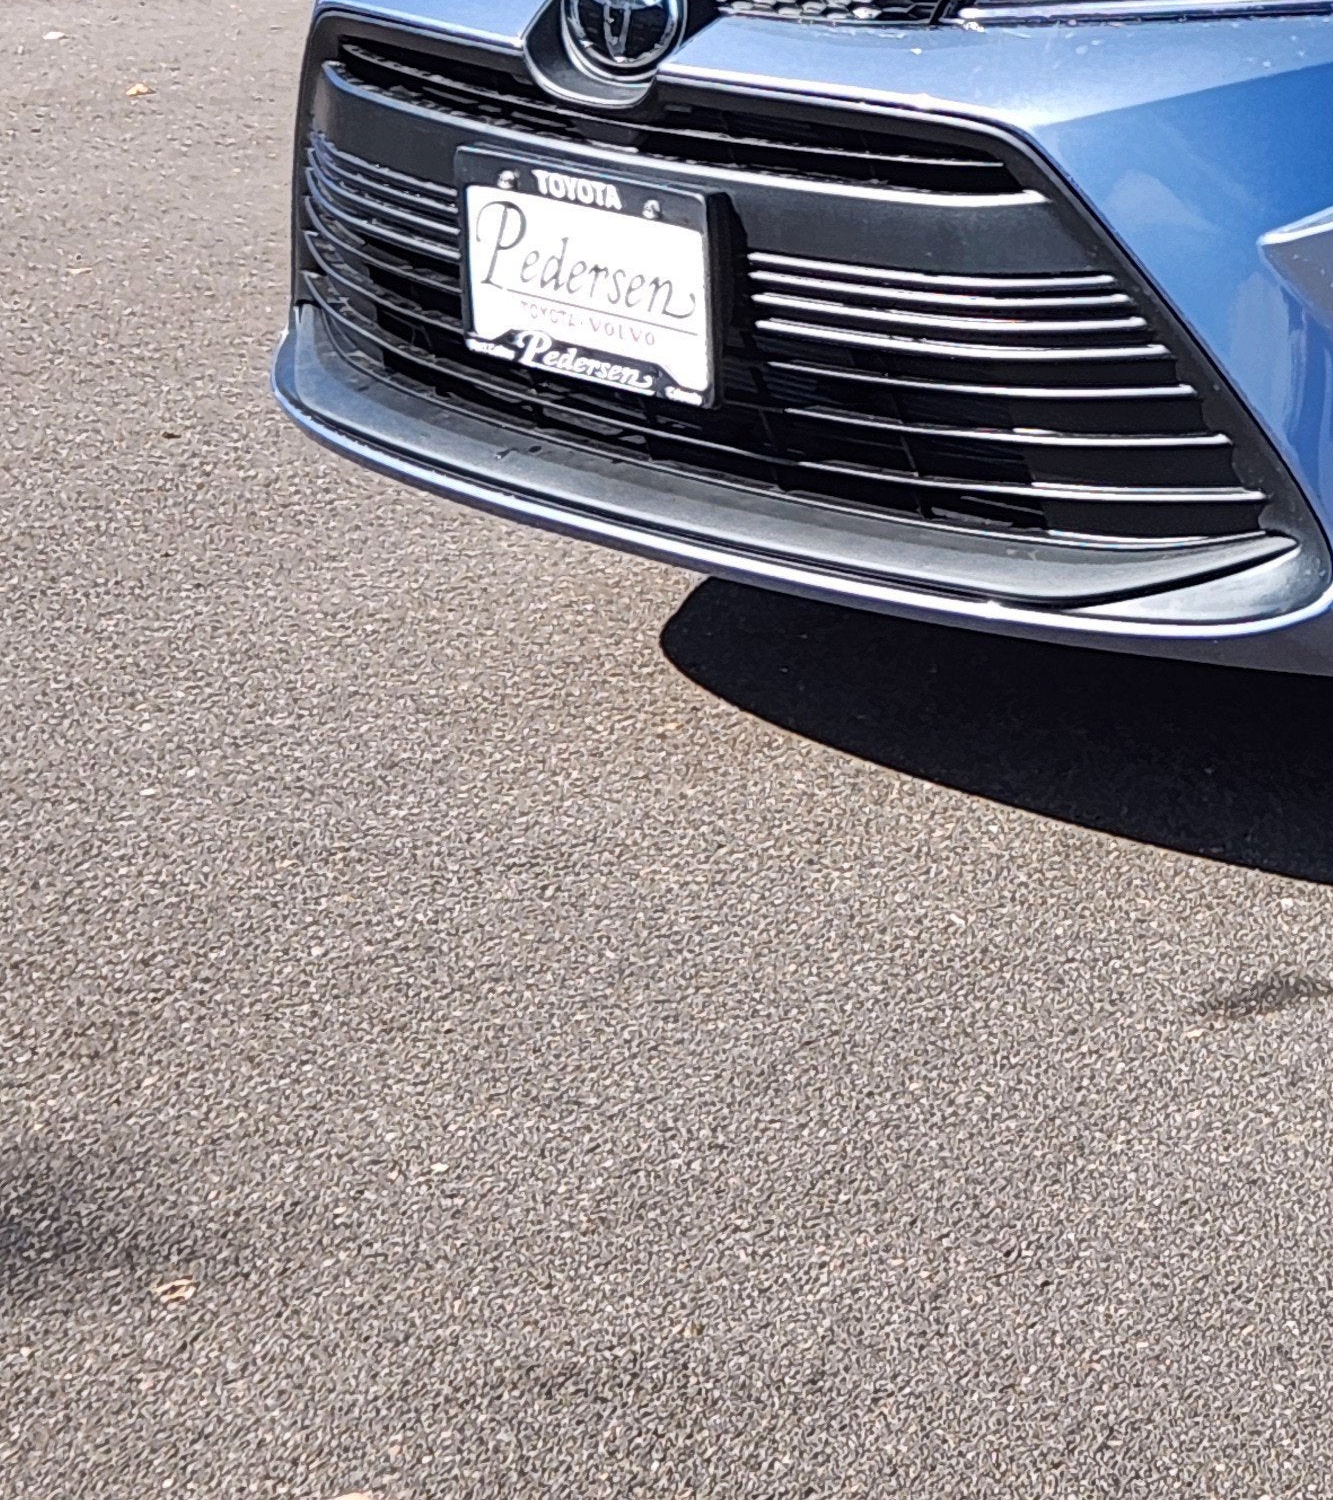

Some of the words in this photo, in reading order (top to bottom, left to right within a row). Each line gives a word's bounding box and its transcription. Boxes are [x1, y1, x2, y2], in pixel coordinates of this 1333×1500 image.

[531, 169, 622, 211] TOYOTA
[476, 200, 696, 319] Pedersen
[588, 316, 656, 346] VOLVO
[514, 329, 654, 389] Pedersen
